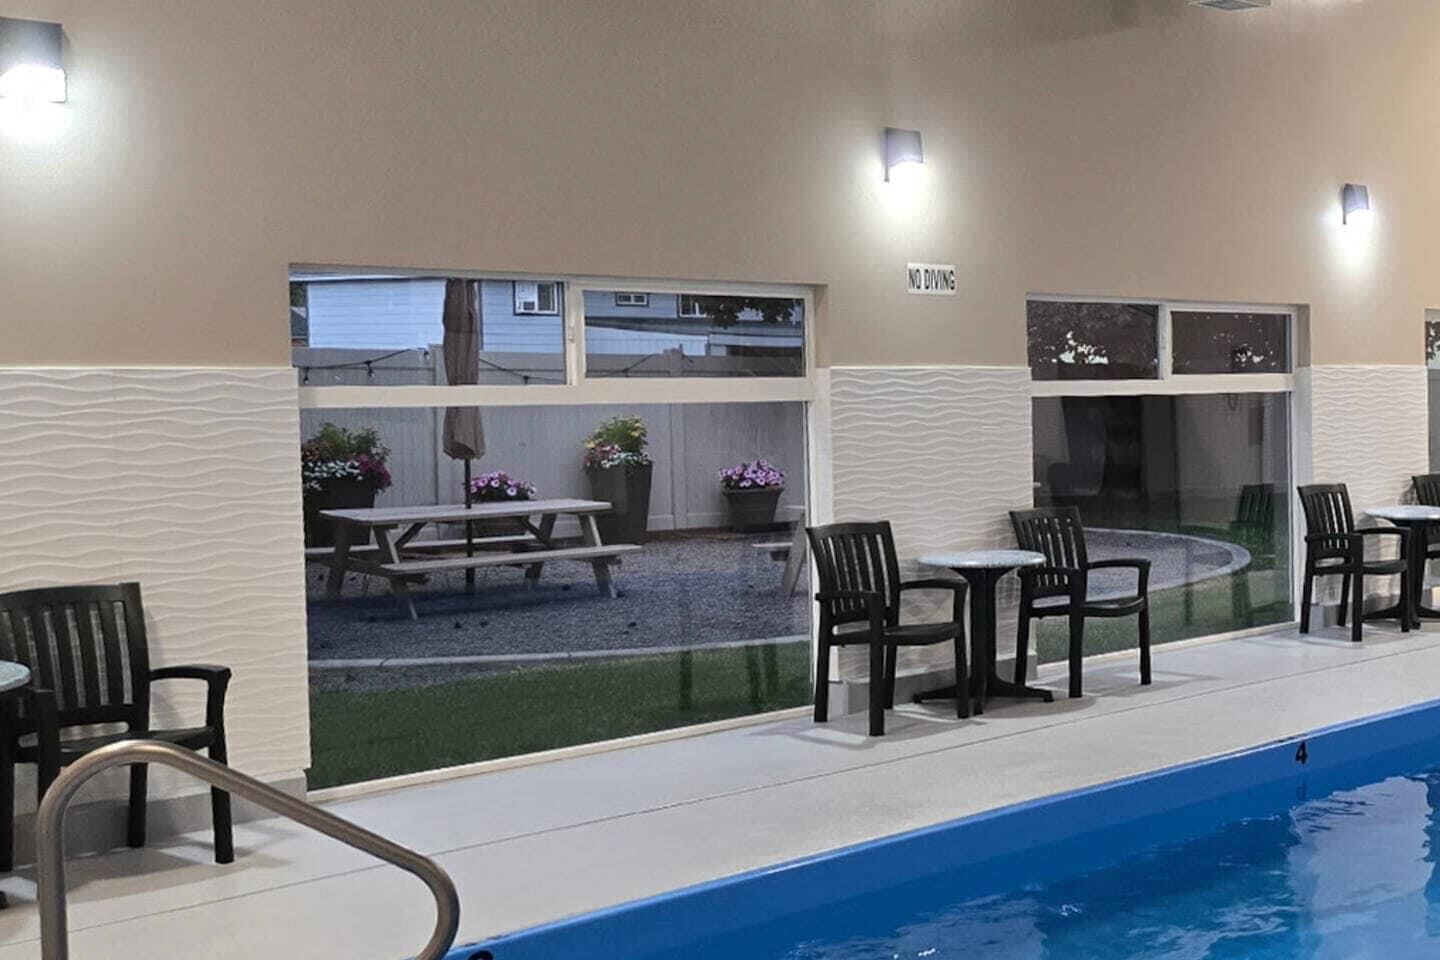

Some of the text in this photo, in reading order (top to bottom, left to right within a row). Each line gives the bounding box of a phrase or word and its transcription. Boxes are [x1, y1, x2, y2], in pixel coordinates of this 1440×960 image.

[908, 268, 956, 290] NO DIVING
[1295, 740, 1308, 765] 4
